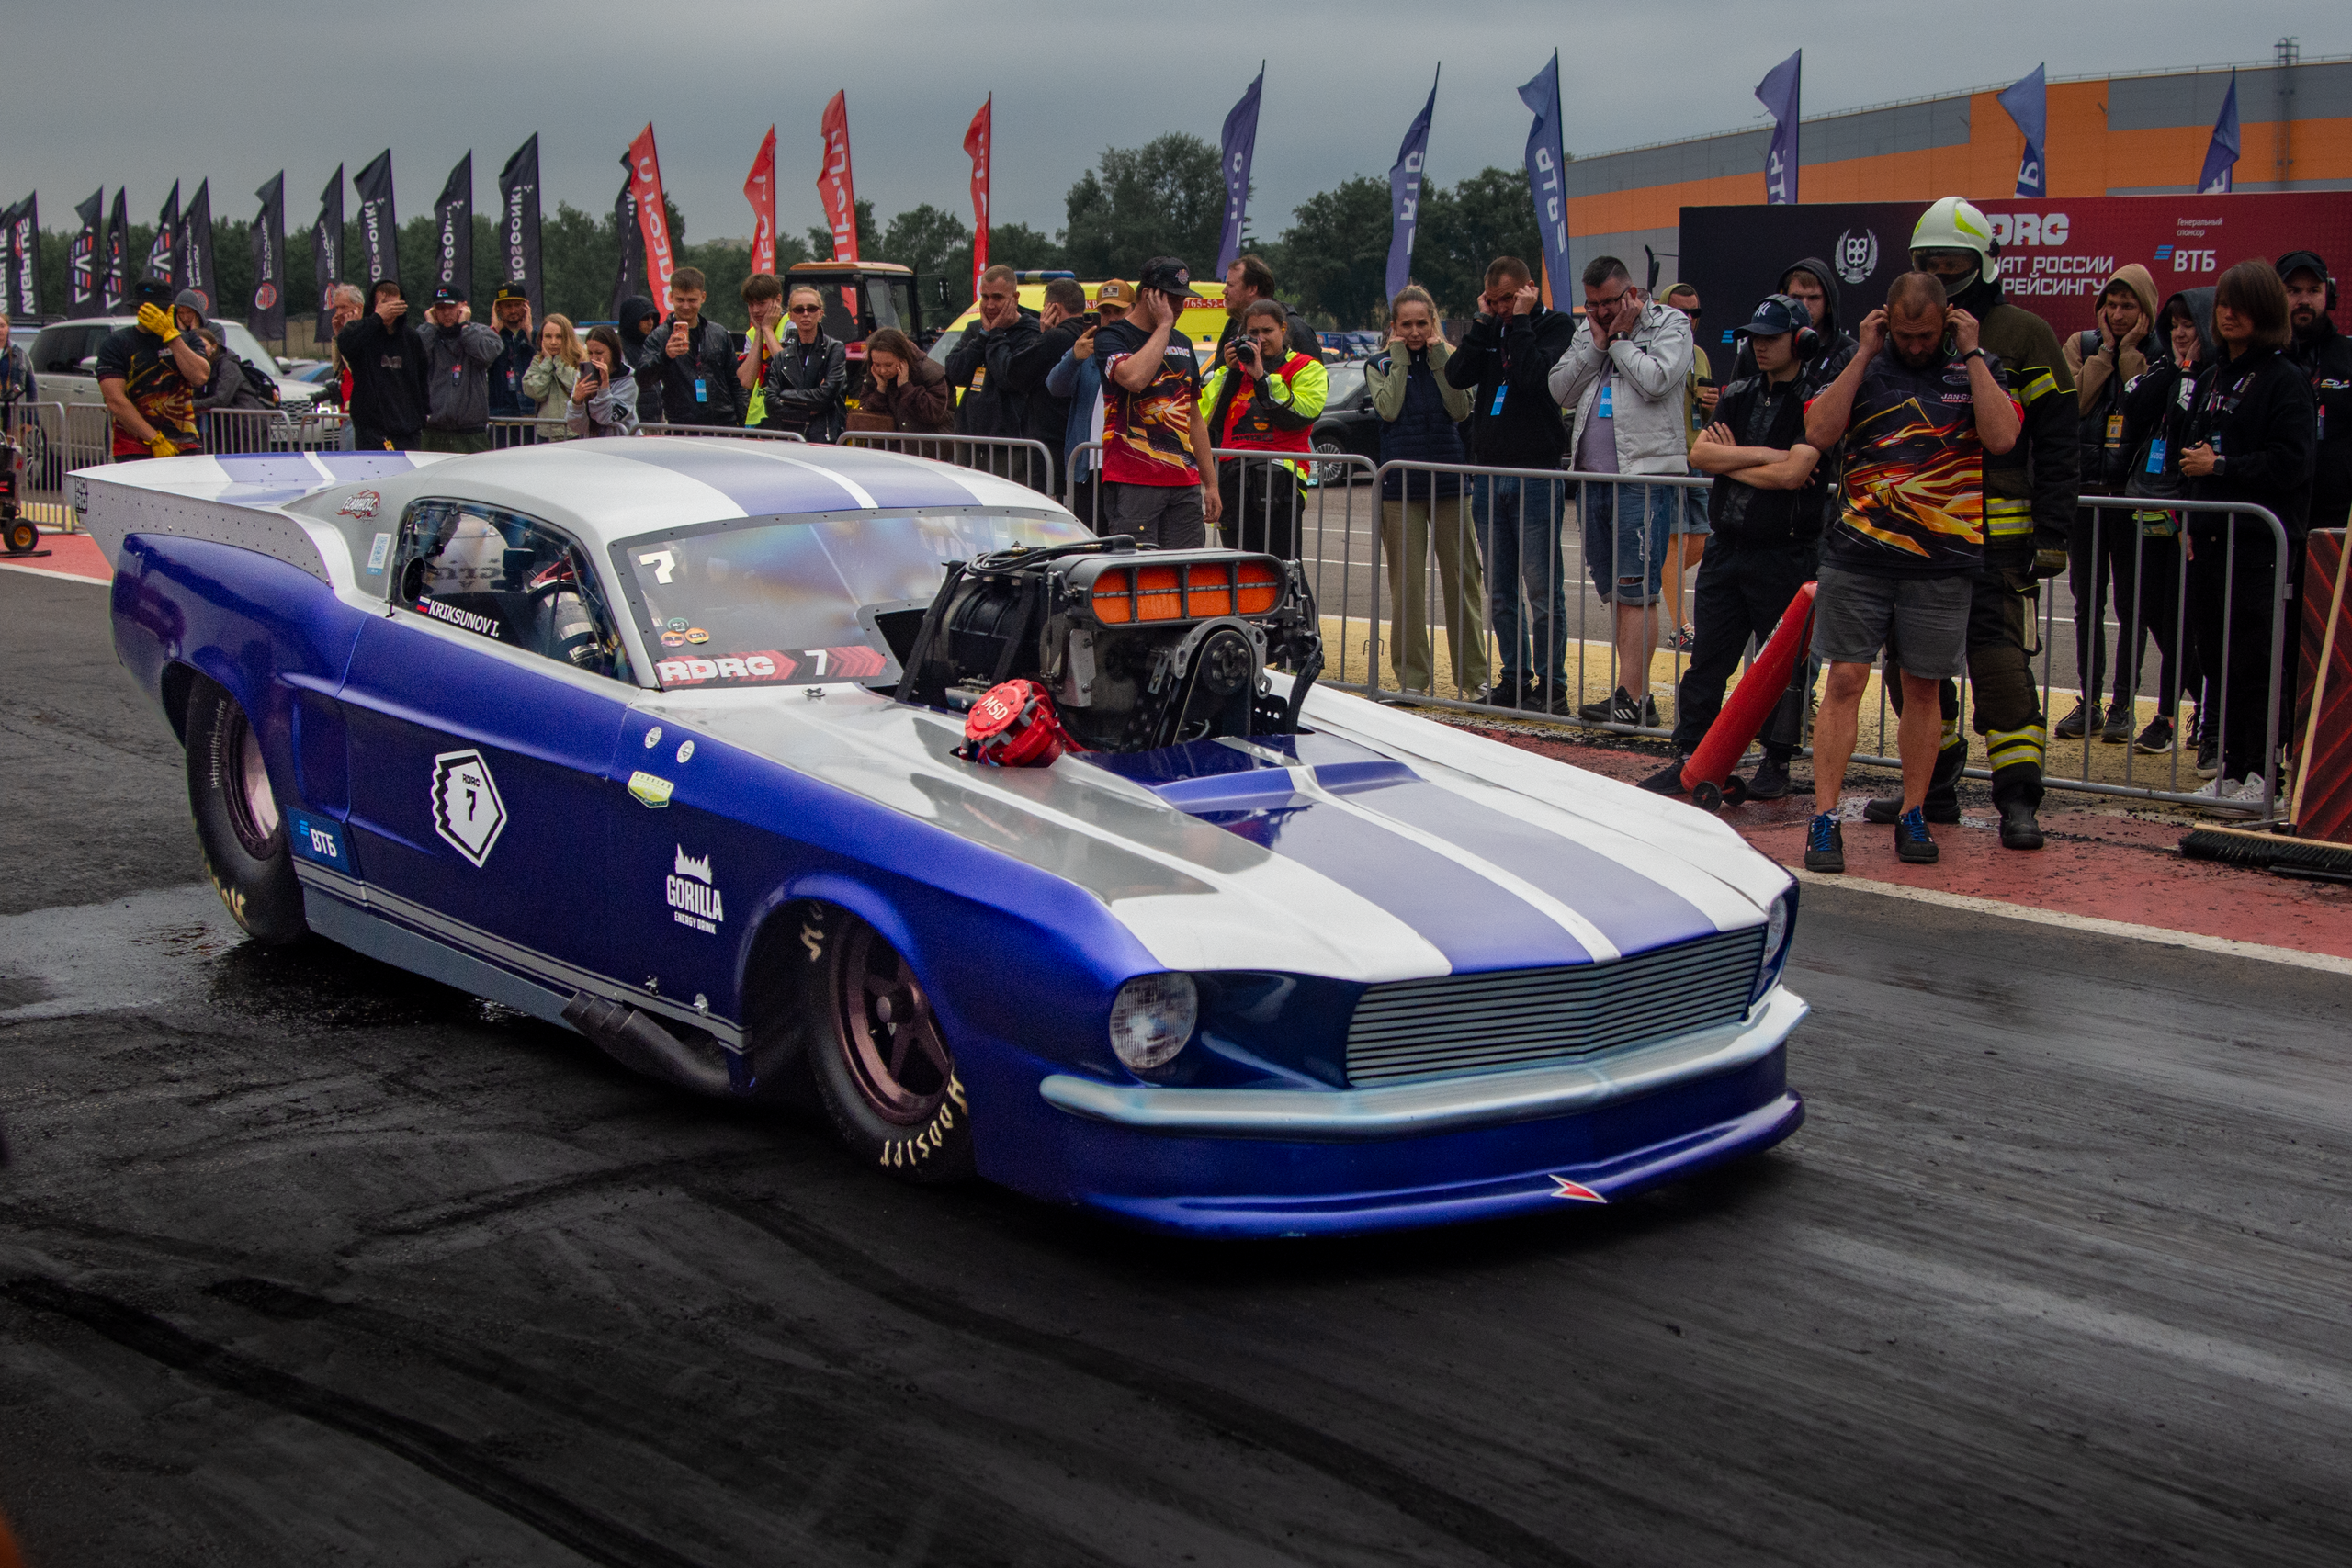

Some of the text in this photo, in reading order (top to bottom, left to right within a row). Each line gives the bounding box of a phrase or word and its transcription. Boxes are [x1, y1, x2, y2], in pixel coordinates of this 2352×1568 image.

[1986, 213, 2069, 246] DRC
[2176, 229, 2206, 238] спонсор
[2177, 217, 2223, 228] Генеральный
[2032, 256, 2114, 274] РОССИИ
[2173, 249, 2217, 272] ВТБ
[639, 551, 675, 584] 7
[428, 599, 500, 637] KRIKSUNOV I.
[656, 649, 827, 682] RDRC 7
[980, 695, 1009, 721] MSD
[462, 773, 480, 787] RDRC
[466, 788, 477, 822] 7
[310, 828, 338, 858] ВТБ
[666, 874, 724, 922] GORILLA
[673, 910, 717, 935] ENERGY DRINK
